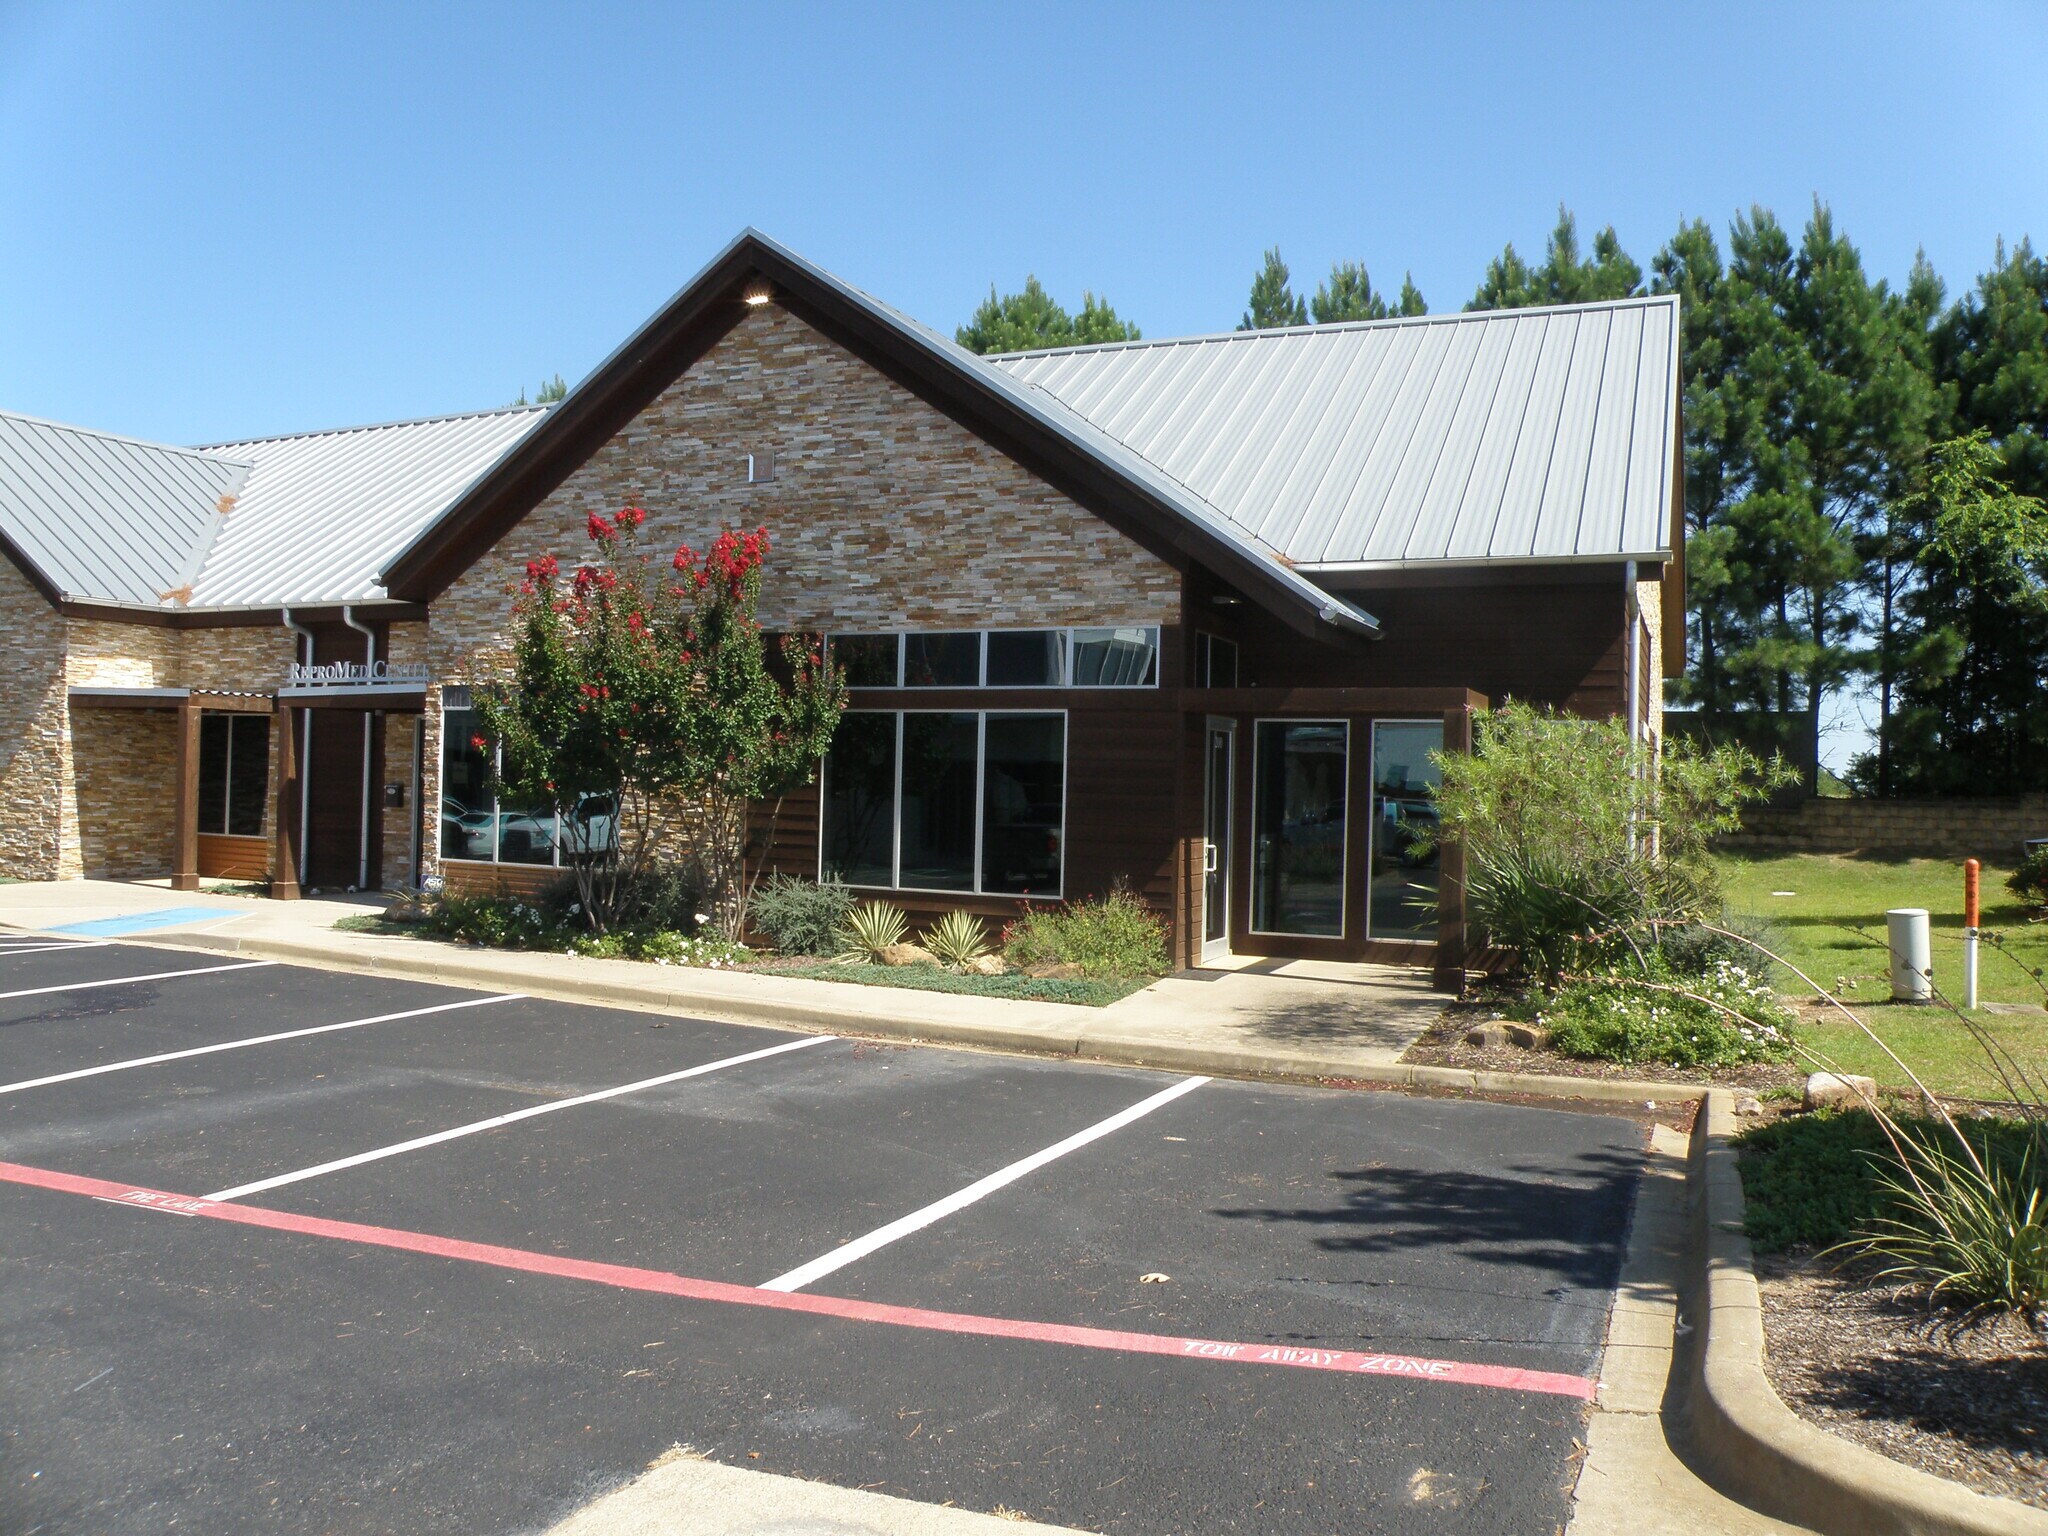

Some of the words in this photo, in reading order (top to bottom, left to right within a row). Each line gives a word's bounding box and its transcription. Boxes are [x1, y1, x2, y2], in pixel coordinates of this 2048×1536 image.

[1184, 1341, 1244, 1357] TOW
[1259, 1348, 1342, 1366] AWAY
[1359, 1356, 1453, 1376] ZONE
